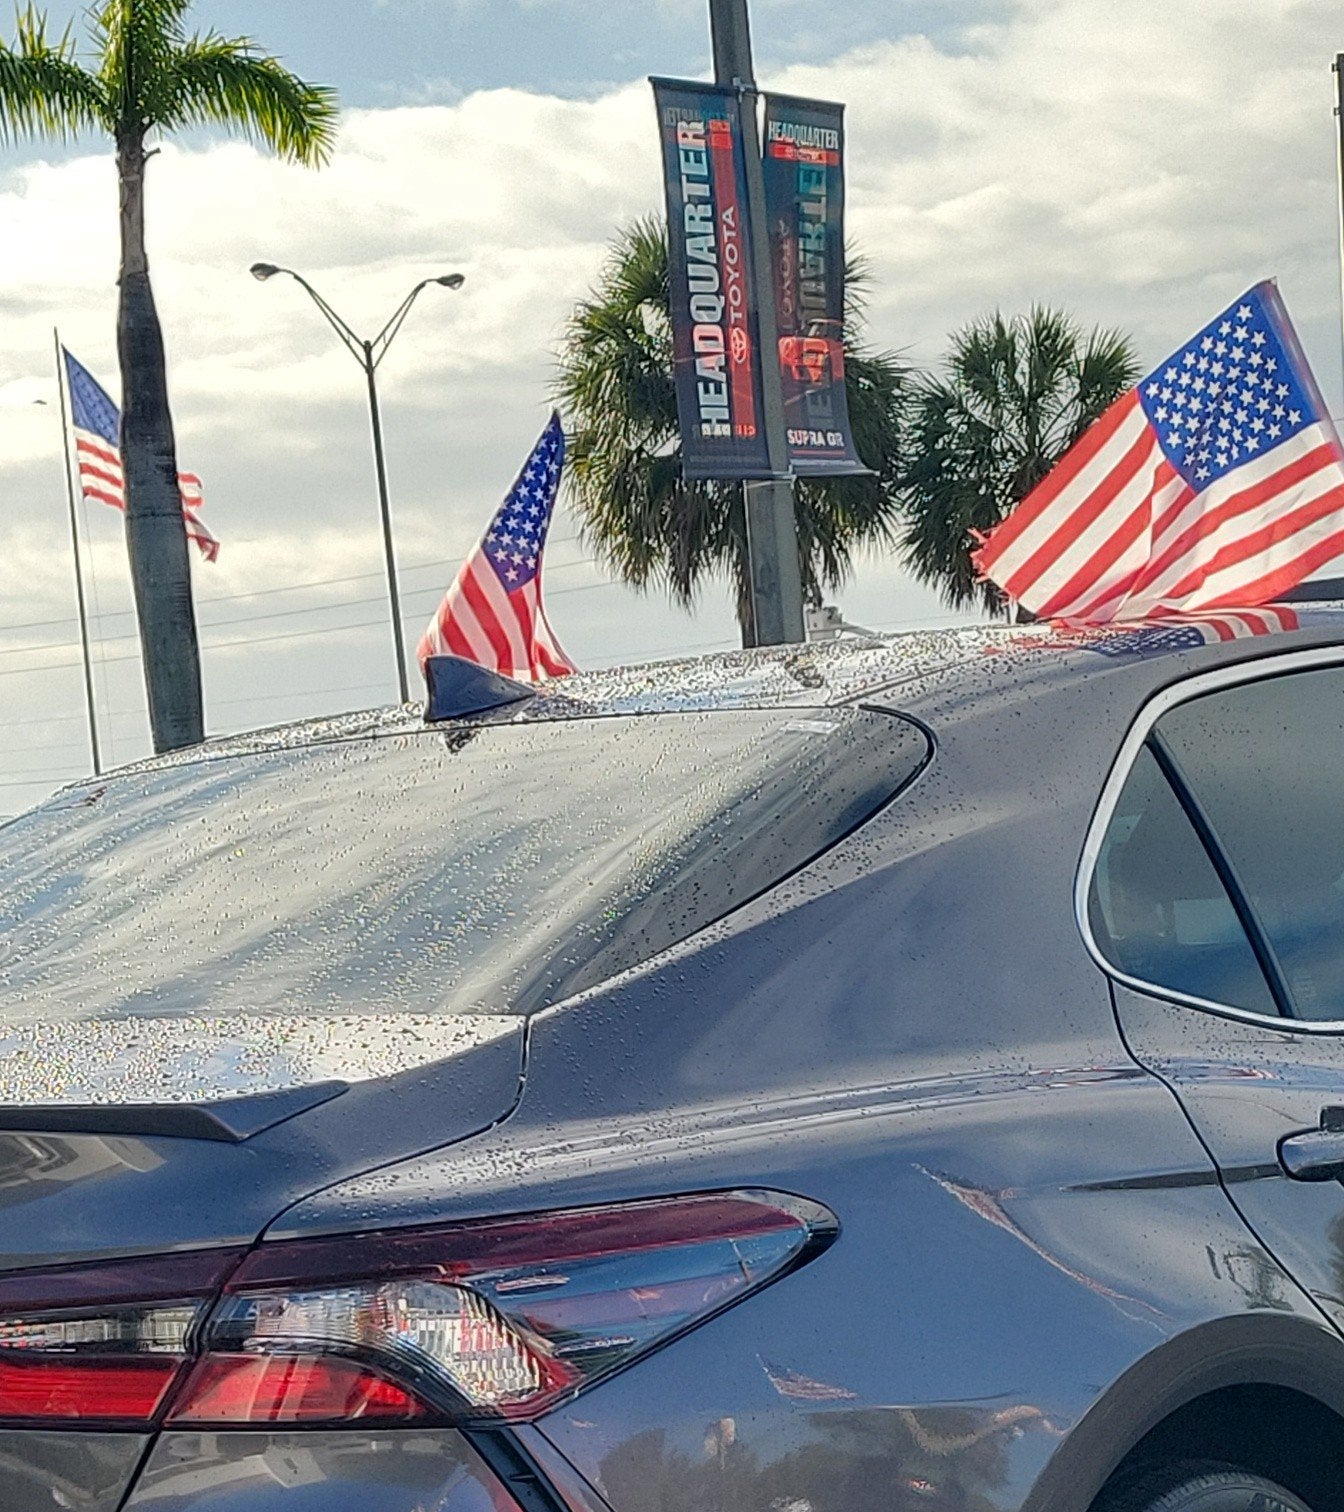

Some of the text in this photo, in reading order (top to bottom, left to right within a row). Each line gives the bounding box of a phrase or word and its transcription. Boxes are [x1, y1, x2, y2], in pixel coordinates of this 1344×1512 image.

[768, 121, 839, 150] HEADQUARTER
[677, 120, 732, 437] HEADQUARTER
[723, 205, 742, 324] TOYOTA
[787, 429, 826, 446] SUPRA
